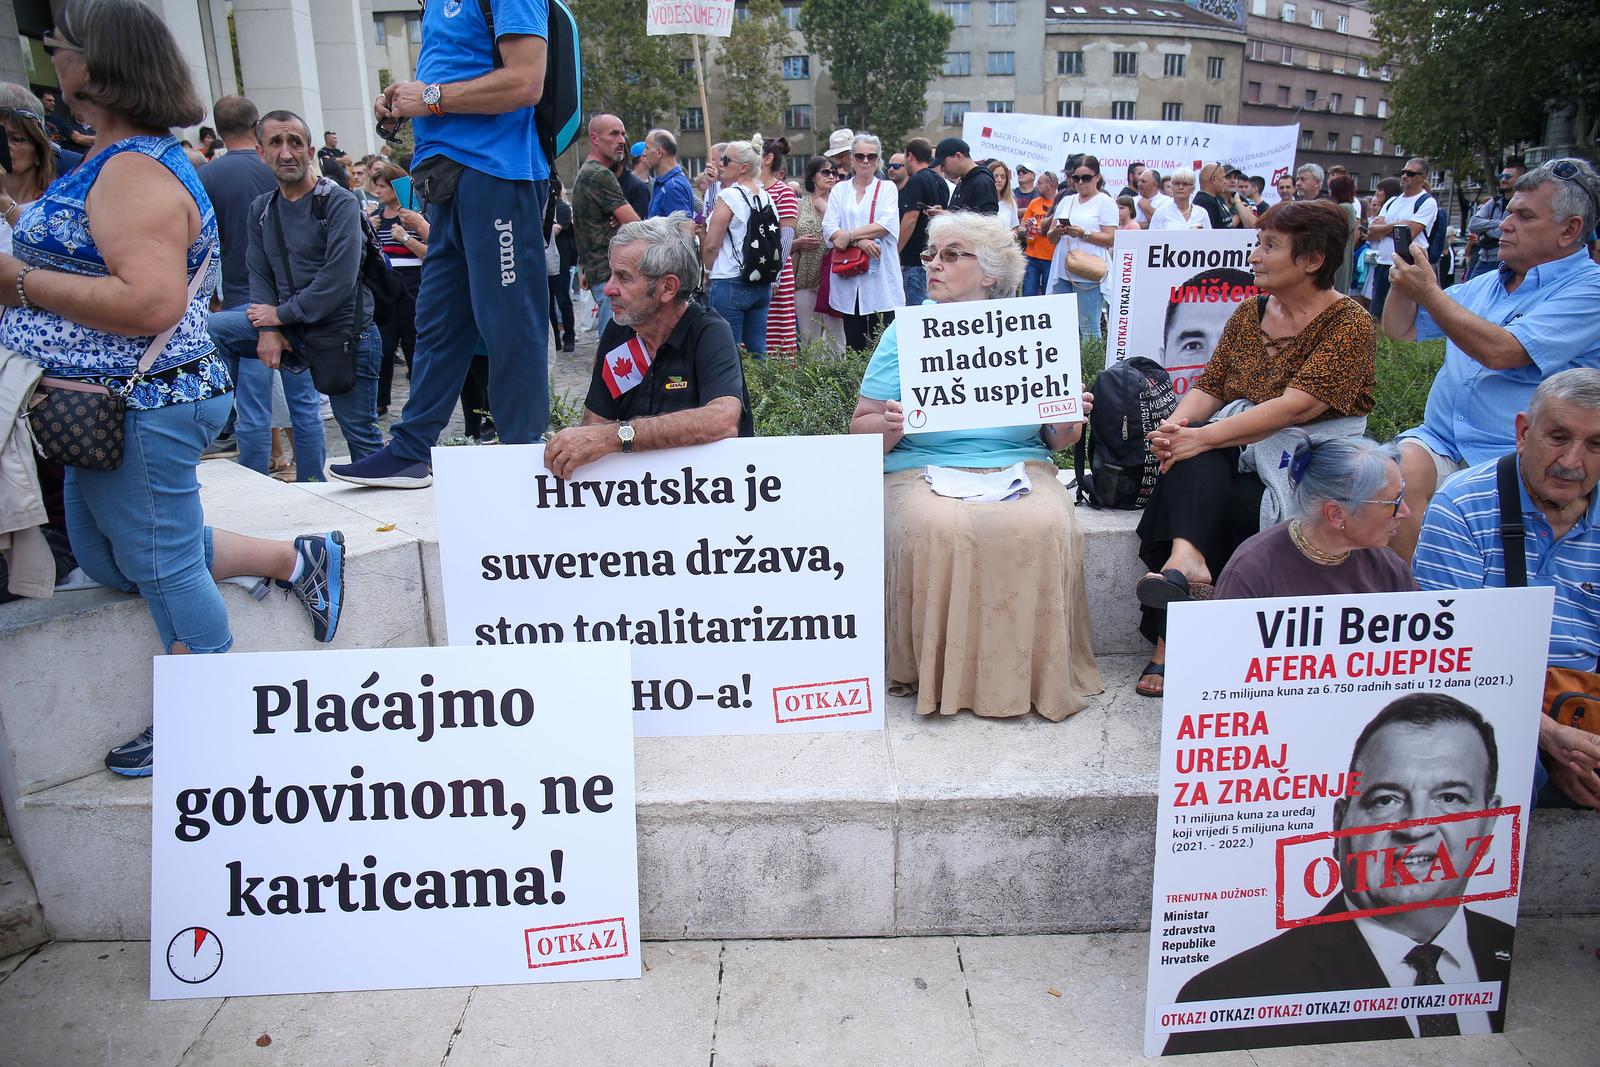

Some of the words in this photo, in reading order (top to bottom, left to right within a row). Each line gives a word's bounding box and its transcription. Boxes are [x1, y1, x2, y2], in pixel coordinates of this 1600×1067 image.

[981, 141, 1026, 156] POMORSKOM
[993, 131, 1020, 142] NACRTU
[1021, 138, 1046, 151] ZAKONA
[1063, 132, 1124, 145] DAJEMO
[1130, 134, 1161, 146] VAM
[1166, 135, 1211, 148] OTKAZ
[495, 219, 516, 287] Joma
[1122, 252, 1133, 284] OTKAZ!
[1120, 285, 1131, 315] OTKAZ!
[922, 310, 1052, 338] Raseljena
[1117, 317, 1128, 347] OTKAZ!
[920, 345, 1029, 373] mladost
[1035, 341, 1058, 369] je
[912, 377, 966, 407] VAŠ
[974, 373, 1070, 406] uspjeh!
[1042, 402, 1074, 414] OTKAZ
[535, 466, 735, 509] Hrvatska
[744, 464, 782, 512] je
[481, 548, 676, 581] suverena
[686, 535, 845, 581] država,
[574, 605, 857, 645] totalitarizmu
[1256, 605, 1324, 649] Vili
[1338, 599, 1457, 645] Beroš
[1244, 654, 1338, 683] AFERA
[1346, 647, 1474, 678] CIJEPISE
[632, 673, 753, 711] HO-a!
[784, 687, 863, 713] OTKAZ
[1202, 690, 1227, 701] 2.75
[1230, 687, 1274, 701] milijuna
[1277, 685, 1304, 697] kuna
[1306, 686, 1320, 695] za
[1323, 683, 1354, 694] 6.750
[1356, 680, 1391, 693] radnih
[1394, 679, 1415, 691] sati
[1417, 680, 1425, 689] u
[1428, 677, 1441, 688] 12
[1443, 676, 1471, 688] dana
[1474, 674, 1514, 689] (2021.)
[252, 671, 535, 743] Plaćajmo
[1177, 711, 1269, 740] AFERA
[1176, 743, 1288, 774] UREĐAJ
[1173, 781, 1209, 807] ZA
[1217, 768, 1362, 805] ZRAČENJE
[174, 765, 527, 842] gotovinom,
[540, 772, 615, 815] ne
[1174, 815, 1188, 824] 11
[1190, 811, 1234, 825] milijuna
[1237, 809, 1263, 821] kuna
[1266, 810, 1279, 819] za
[1282, 806, 1316, 819] uređaj
[1172, 829, 1192, 840] koji
[1196, 825, 1229, 838] vrijedi
[1232, 825, 1239, 834] 5
[1241, 822, 1285, 836] milijuna
[1287, 820, 1314, 832] kuna
[1171, 841, 1207, 854] (2021.
[1219, 837, 1254, 850] 2022.)
[1303, 834, 1496, 898] OTKAZ
[226, 849, 567, 917] karticama!
[1165, 890, 1218, 903] TRENUTNA
[1220, 887, 1268, 901] DUŽNOST:
[1162, 923, 1216, 936] zdravstva
[1163, 909, 1209, 922] Ministar
[537, 929, 619, 956] OTKAZ
[1162, 936, 1216, 951] Republike
[1161, 952, 1209, 965] Hrvatske
[1161, 1011, 1207, 1026] OTKAZ!
[1209, 1007, 1255, 1023] OTKAZ!
[1257, 1004, 1303, 1020] OTKAZ!
[1305, 1000, 1350, 1016] OTKAZ!
[1353, 997, 1398, 1013] OTKAZ!
[1401, 994, 1445, 1009] OTKAZ!
[1448, 991, 1494, 1006] OTKAZ!
